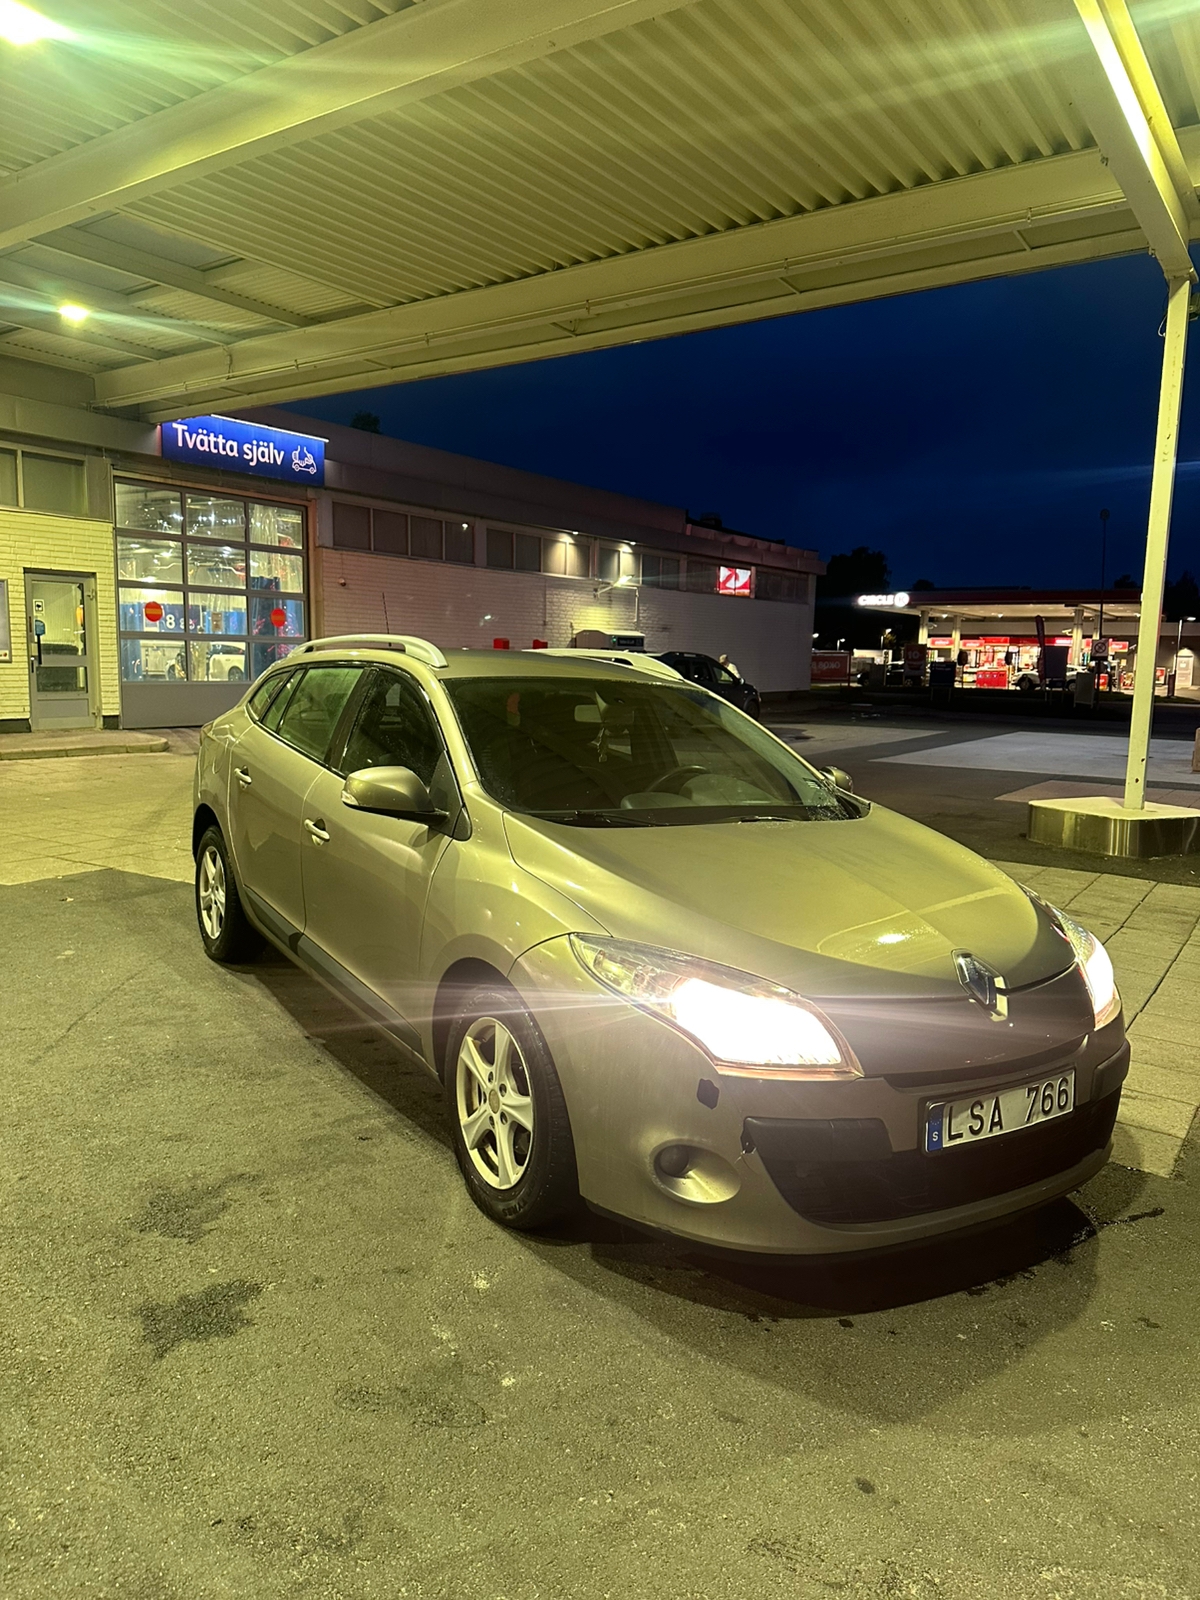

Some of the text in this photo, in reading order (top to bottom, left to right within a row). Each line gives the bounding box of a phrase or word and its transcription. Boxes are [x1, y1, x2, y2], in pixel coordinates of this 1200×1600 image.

[172, 423, 285, 467] Tvätta själv
[858, 594, 895, 606] CIRCLE
[947, 1077, 1069, 1141] LSA 766
[932, 1131, 939, 1142] S
